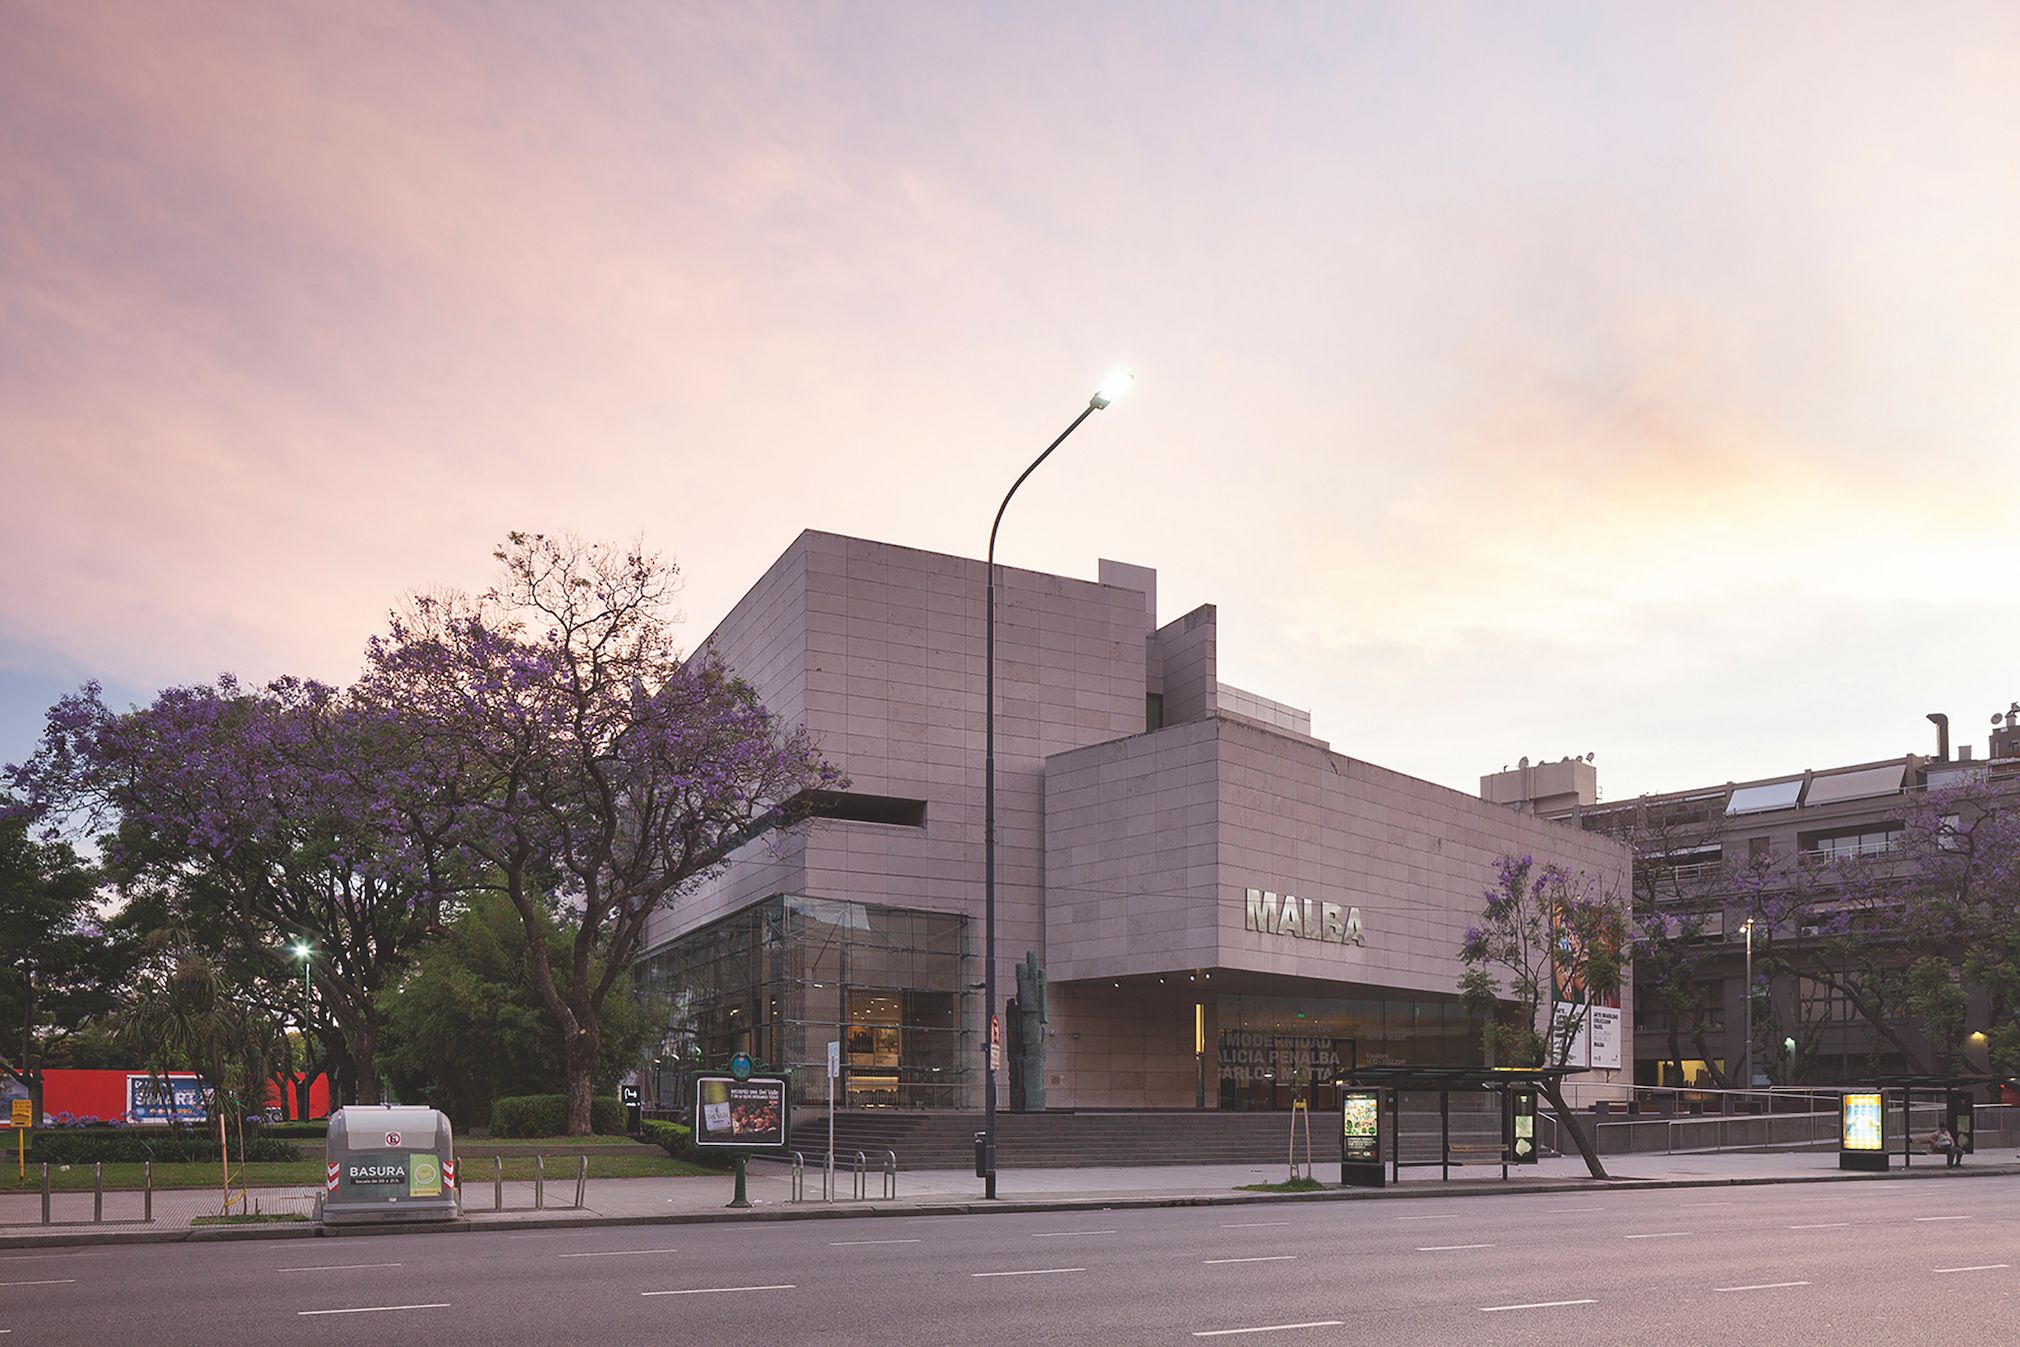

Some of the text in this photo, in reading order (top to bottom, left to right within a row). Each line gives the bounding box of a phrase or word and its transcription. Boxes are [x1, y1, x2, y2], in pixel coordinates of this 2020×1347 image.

[1246, 888, 1365, 947] MALBA
[1226, 1033, 1331, 1048] MODERNIDAD
[1269, 1050, 1340, 1064] PENALBA
[1281, 1067, 1332, 1080] MTTA
[350, 1166, 406, 1177] BASURA
